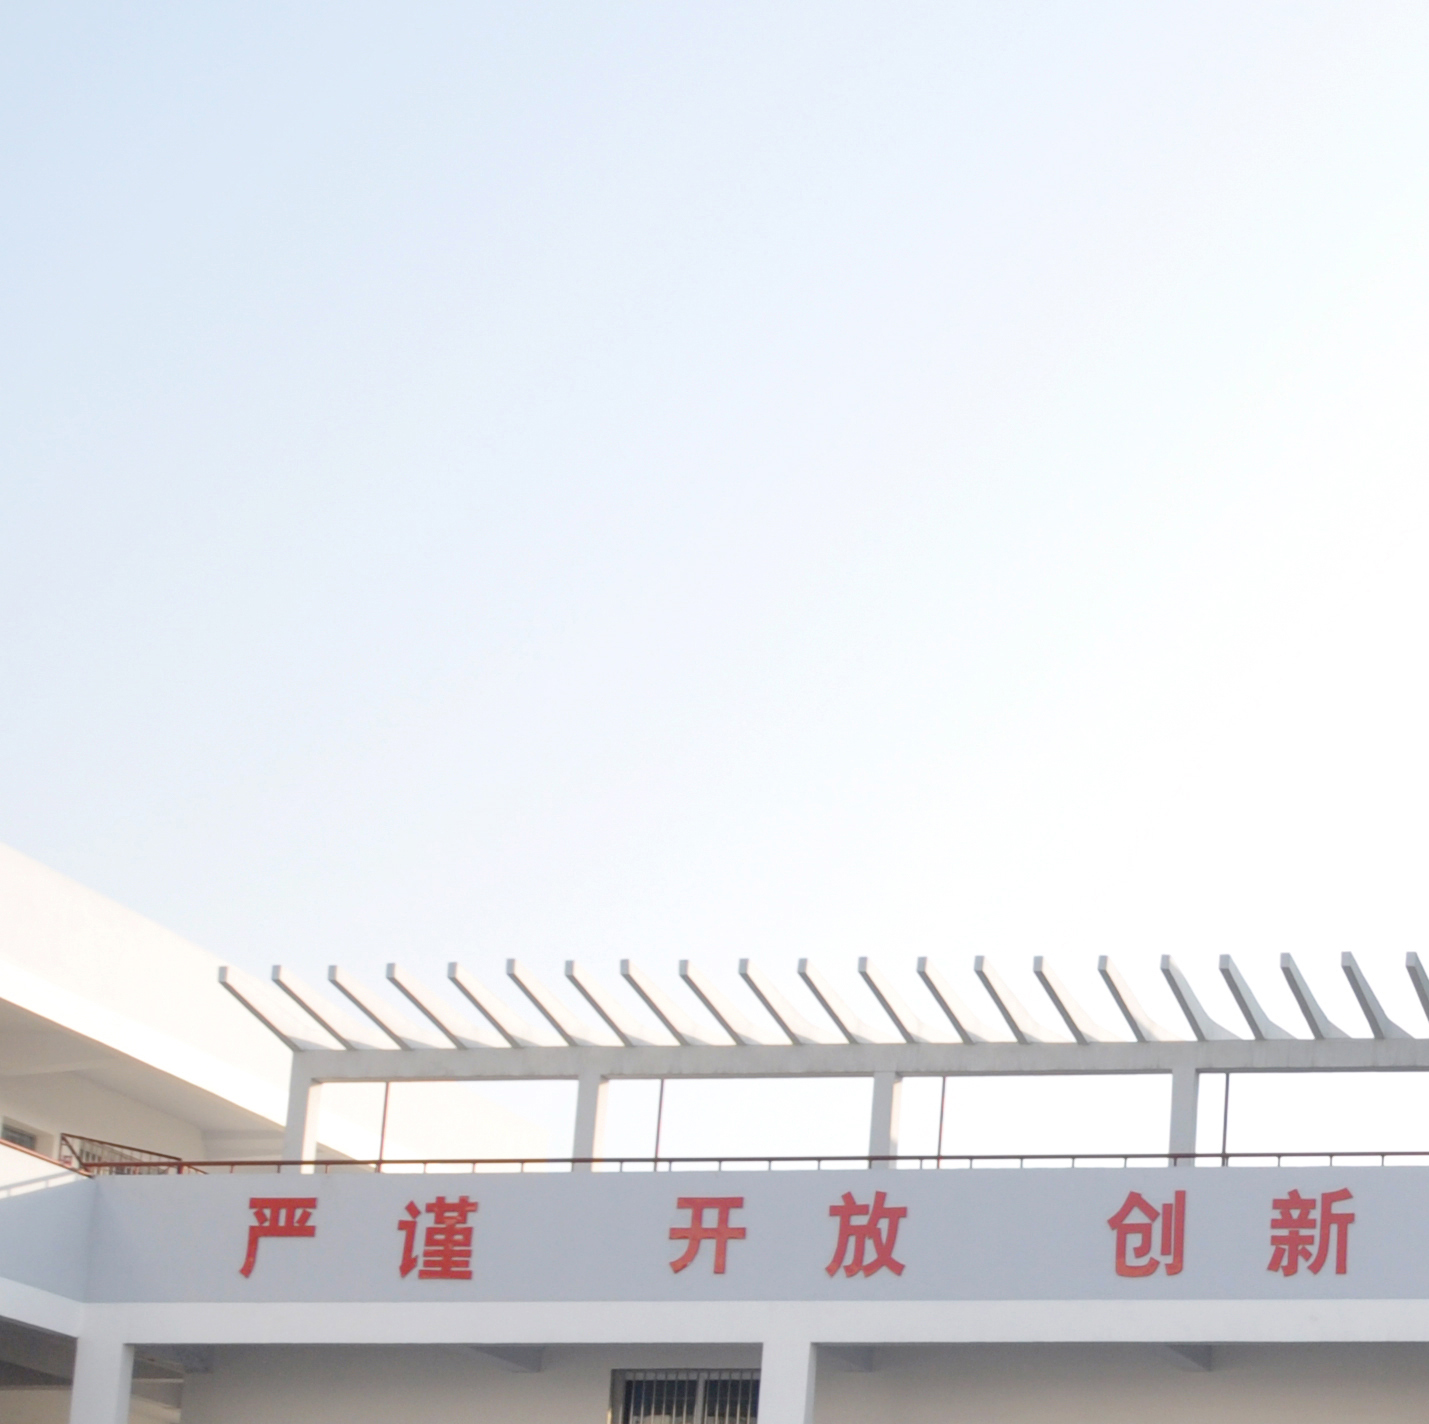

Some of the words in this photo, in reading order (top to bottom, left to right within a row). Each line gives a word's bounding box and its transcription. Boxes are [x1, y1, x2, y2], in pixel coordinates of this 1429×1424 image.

[239, 1195, 479, 1281] 严谨
[669, 1191, 908, 1278] 开放
[1107, 1188, 1355, 1279] 创新
